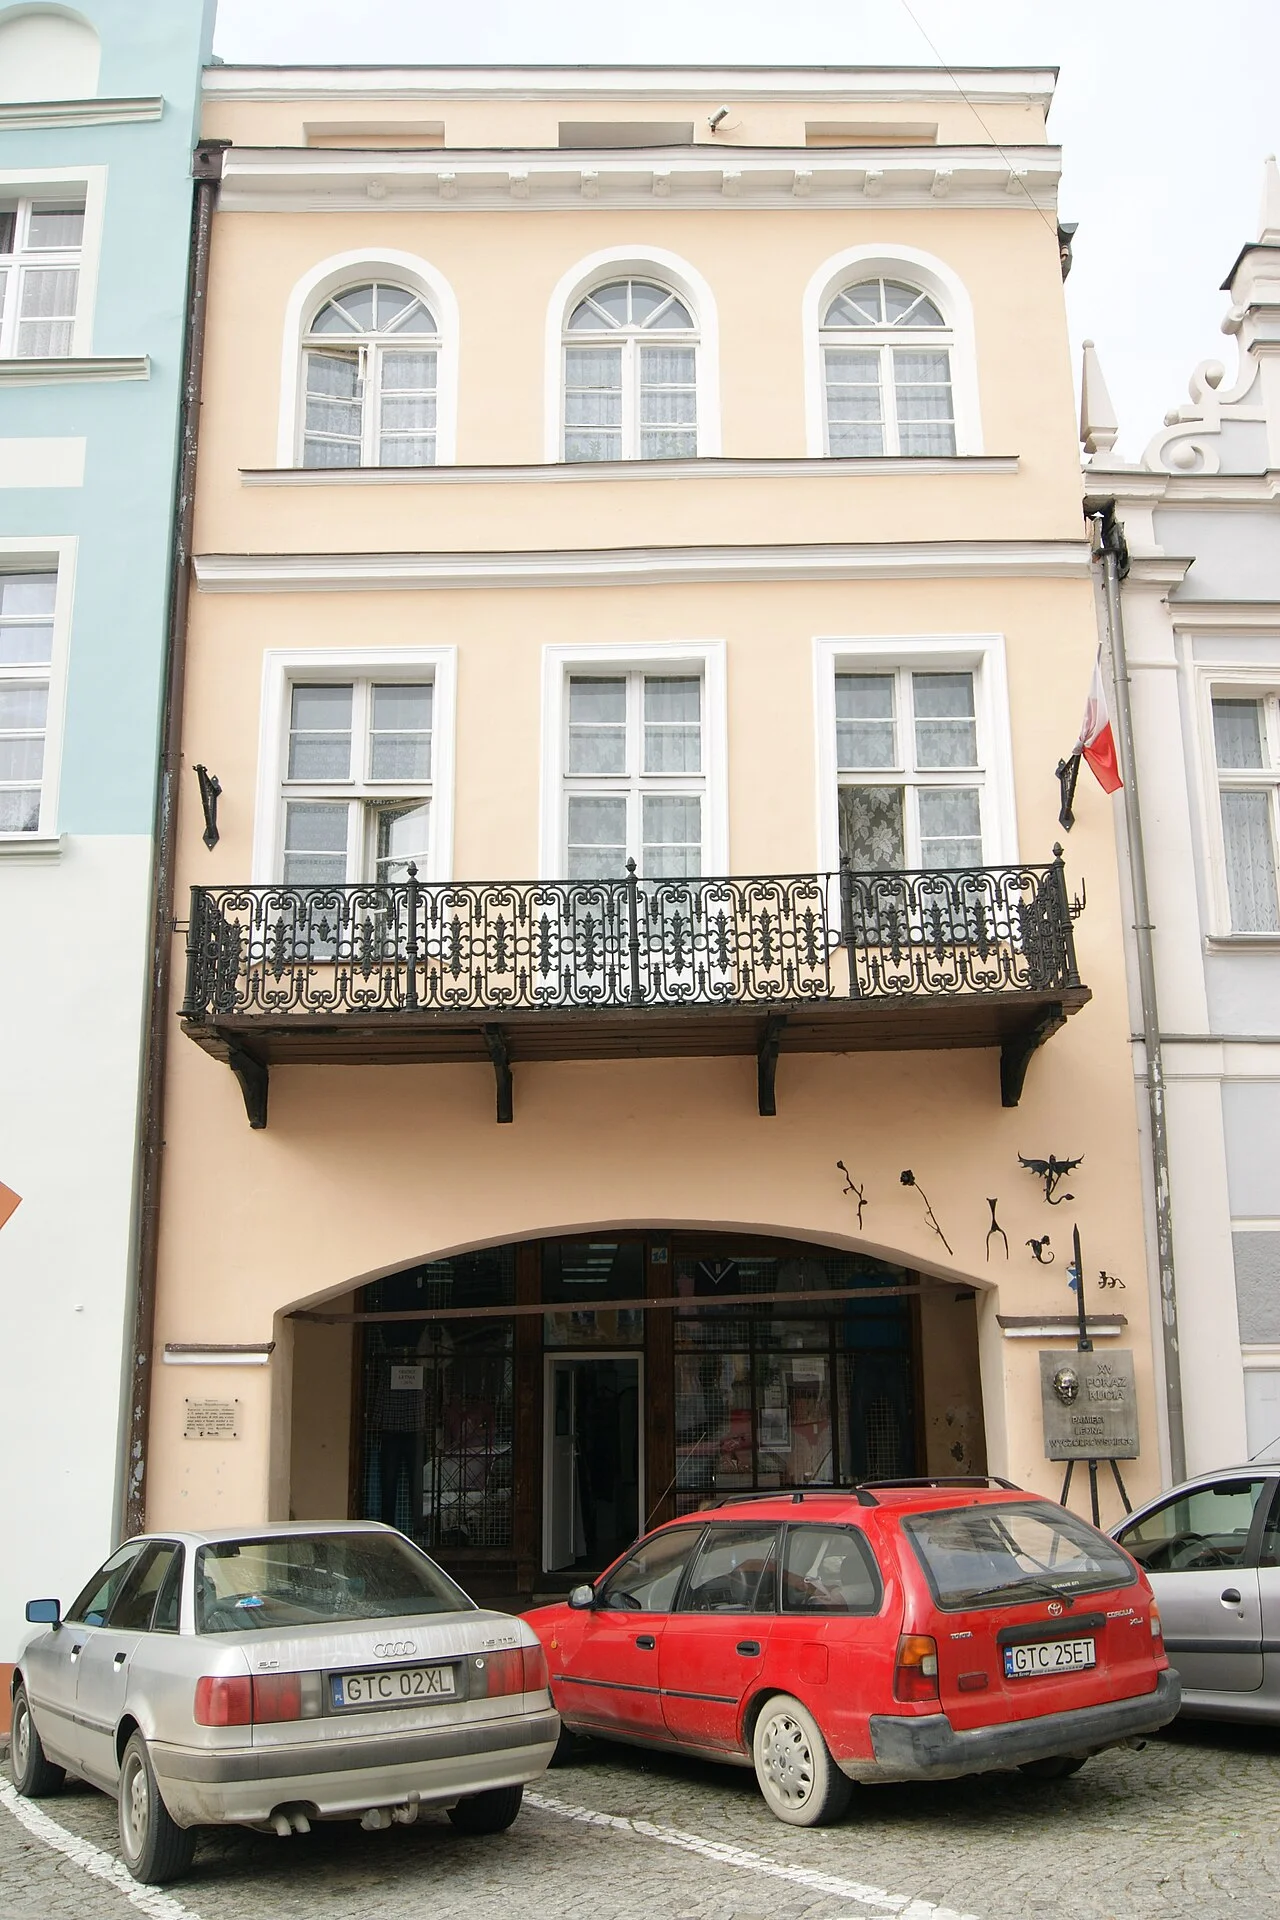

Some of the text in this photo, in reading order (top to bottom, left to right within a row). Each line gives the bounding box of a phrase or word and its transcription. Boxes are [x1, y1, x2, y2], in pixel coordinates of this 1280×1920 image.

[1097, 1364, 1112, 1375] XV
[1085, 1377, 1127, 1388] POKAZ
[1088, 1390, 1125, 1401] KUCIA
[1075, 1427, 1104, 1435] LEONA
[950, 1630, 974, 1640] TOYOTA
[1015, 1641, 1092, 1670] GTC 25ET
[347, 1669, 451, 1701] GTC 02XL
